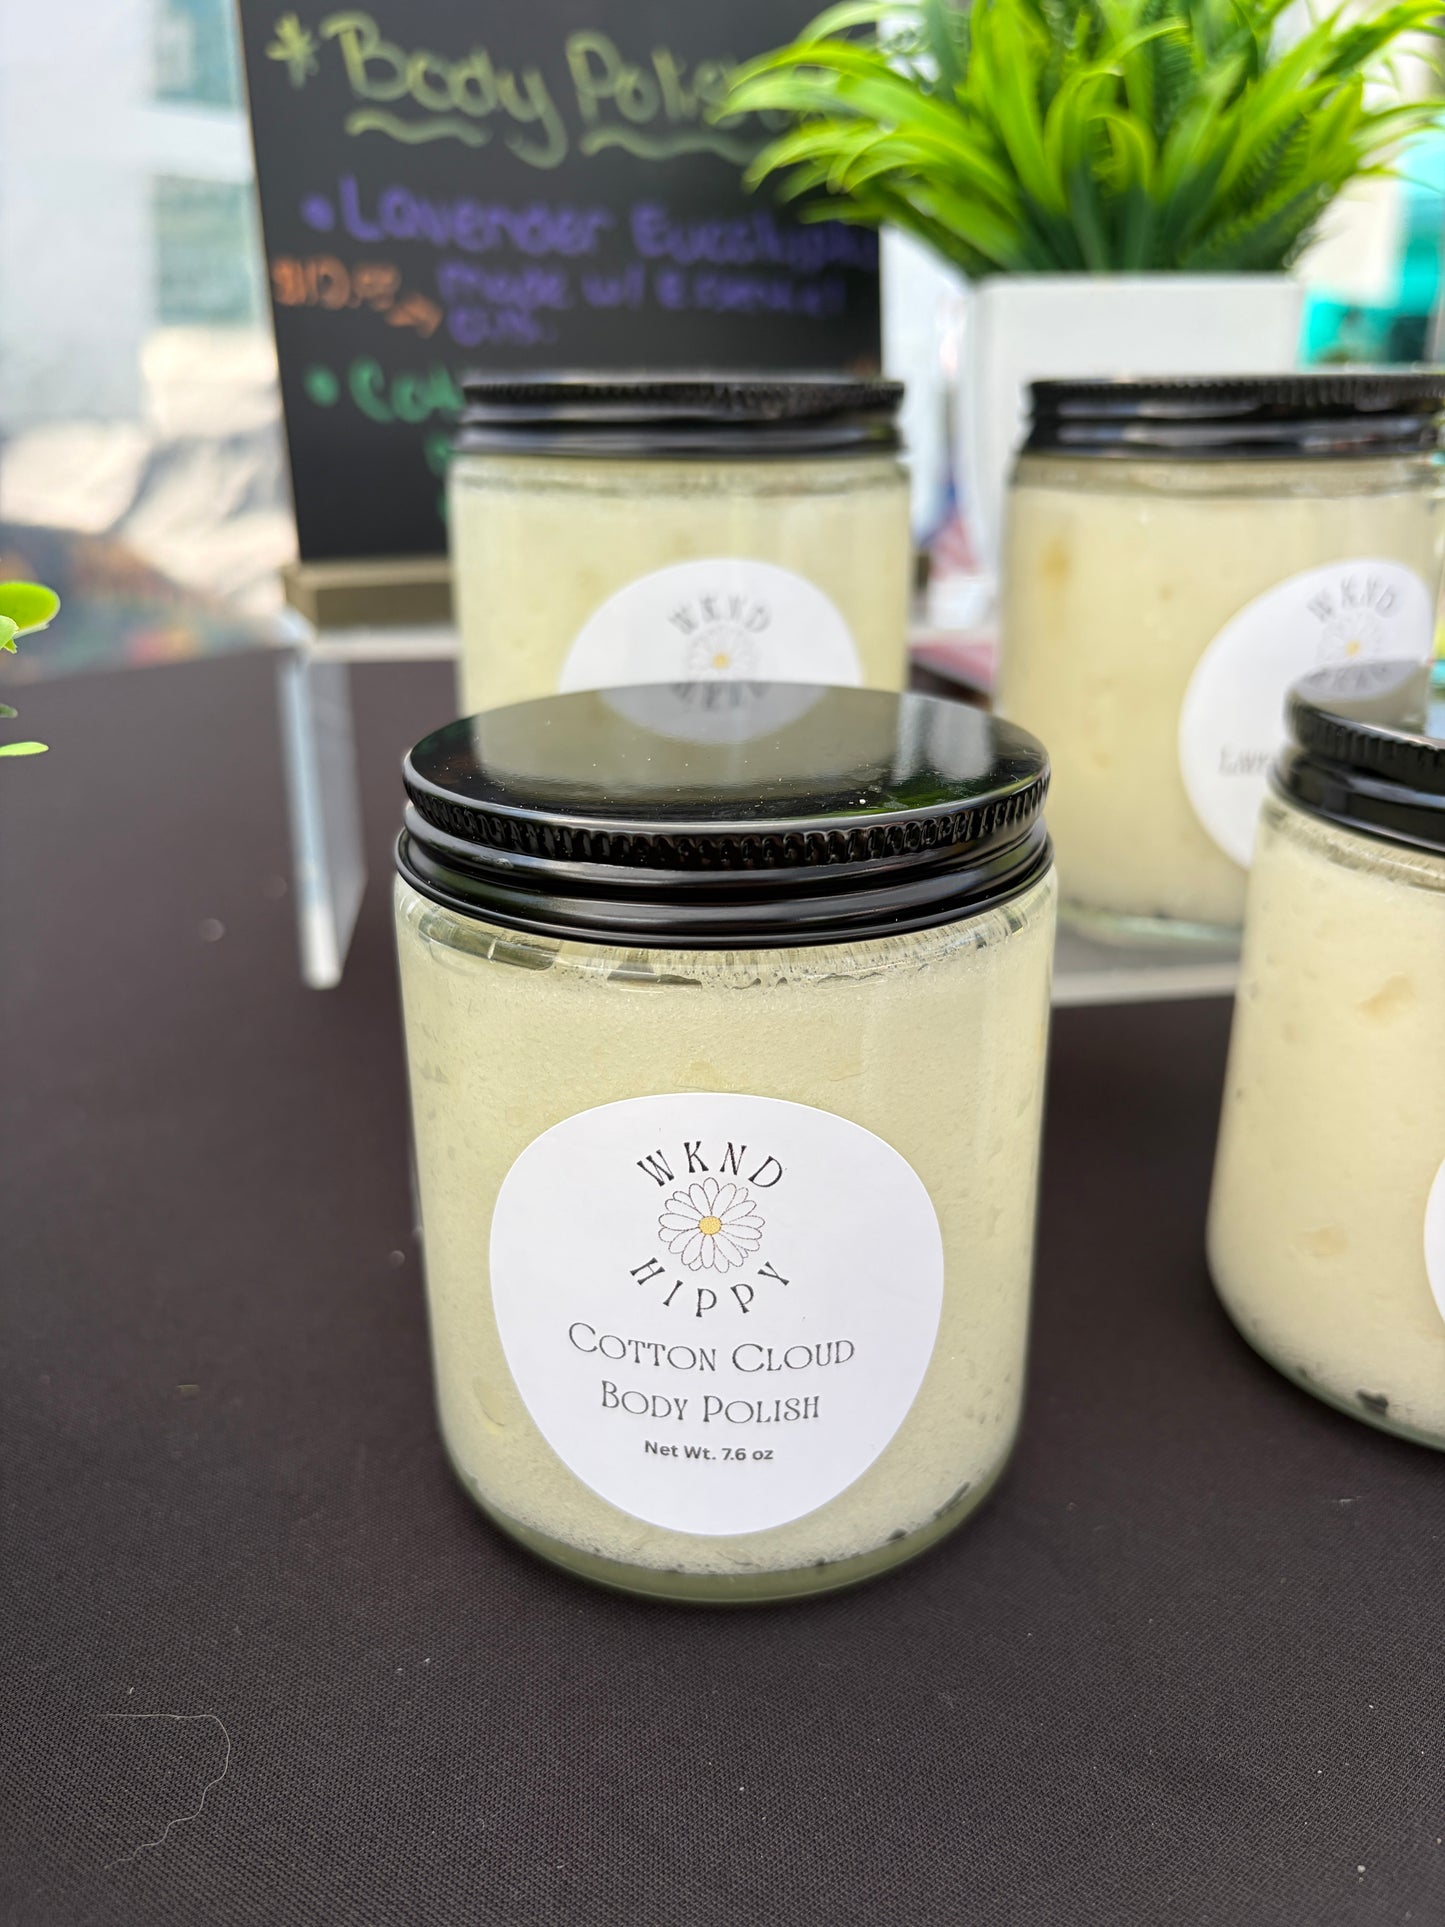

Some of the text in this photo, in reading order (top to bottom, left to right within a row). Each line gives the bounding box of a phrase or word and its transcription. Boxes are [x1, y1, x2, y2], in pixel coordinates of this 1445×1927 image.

[319, 8, 568, 169] Body
[667, 594, 771, 635] WKND
[636, 1140, 783, 1188] WKND
[629, 1256, 790, 1318] HIPPY
[568, 1321, 856, 1373] COTTON CLOUD
[600, 1380, 820, 1424] BODY POLISH
[644, 1439, 774, 1462] Net Wt. 7.6 oz
